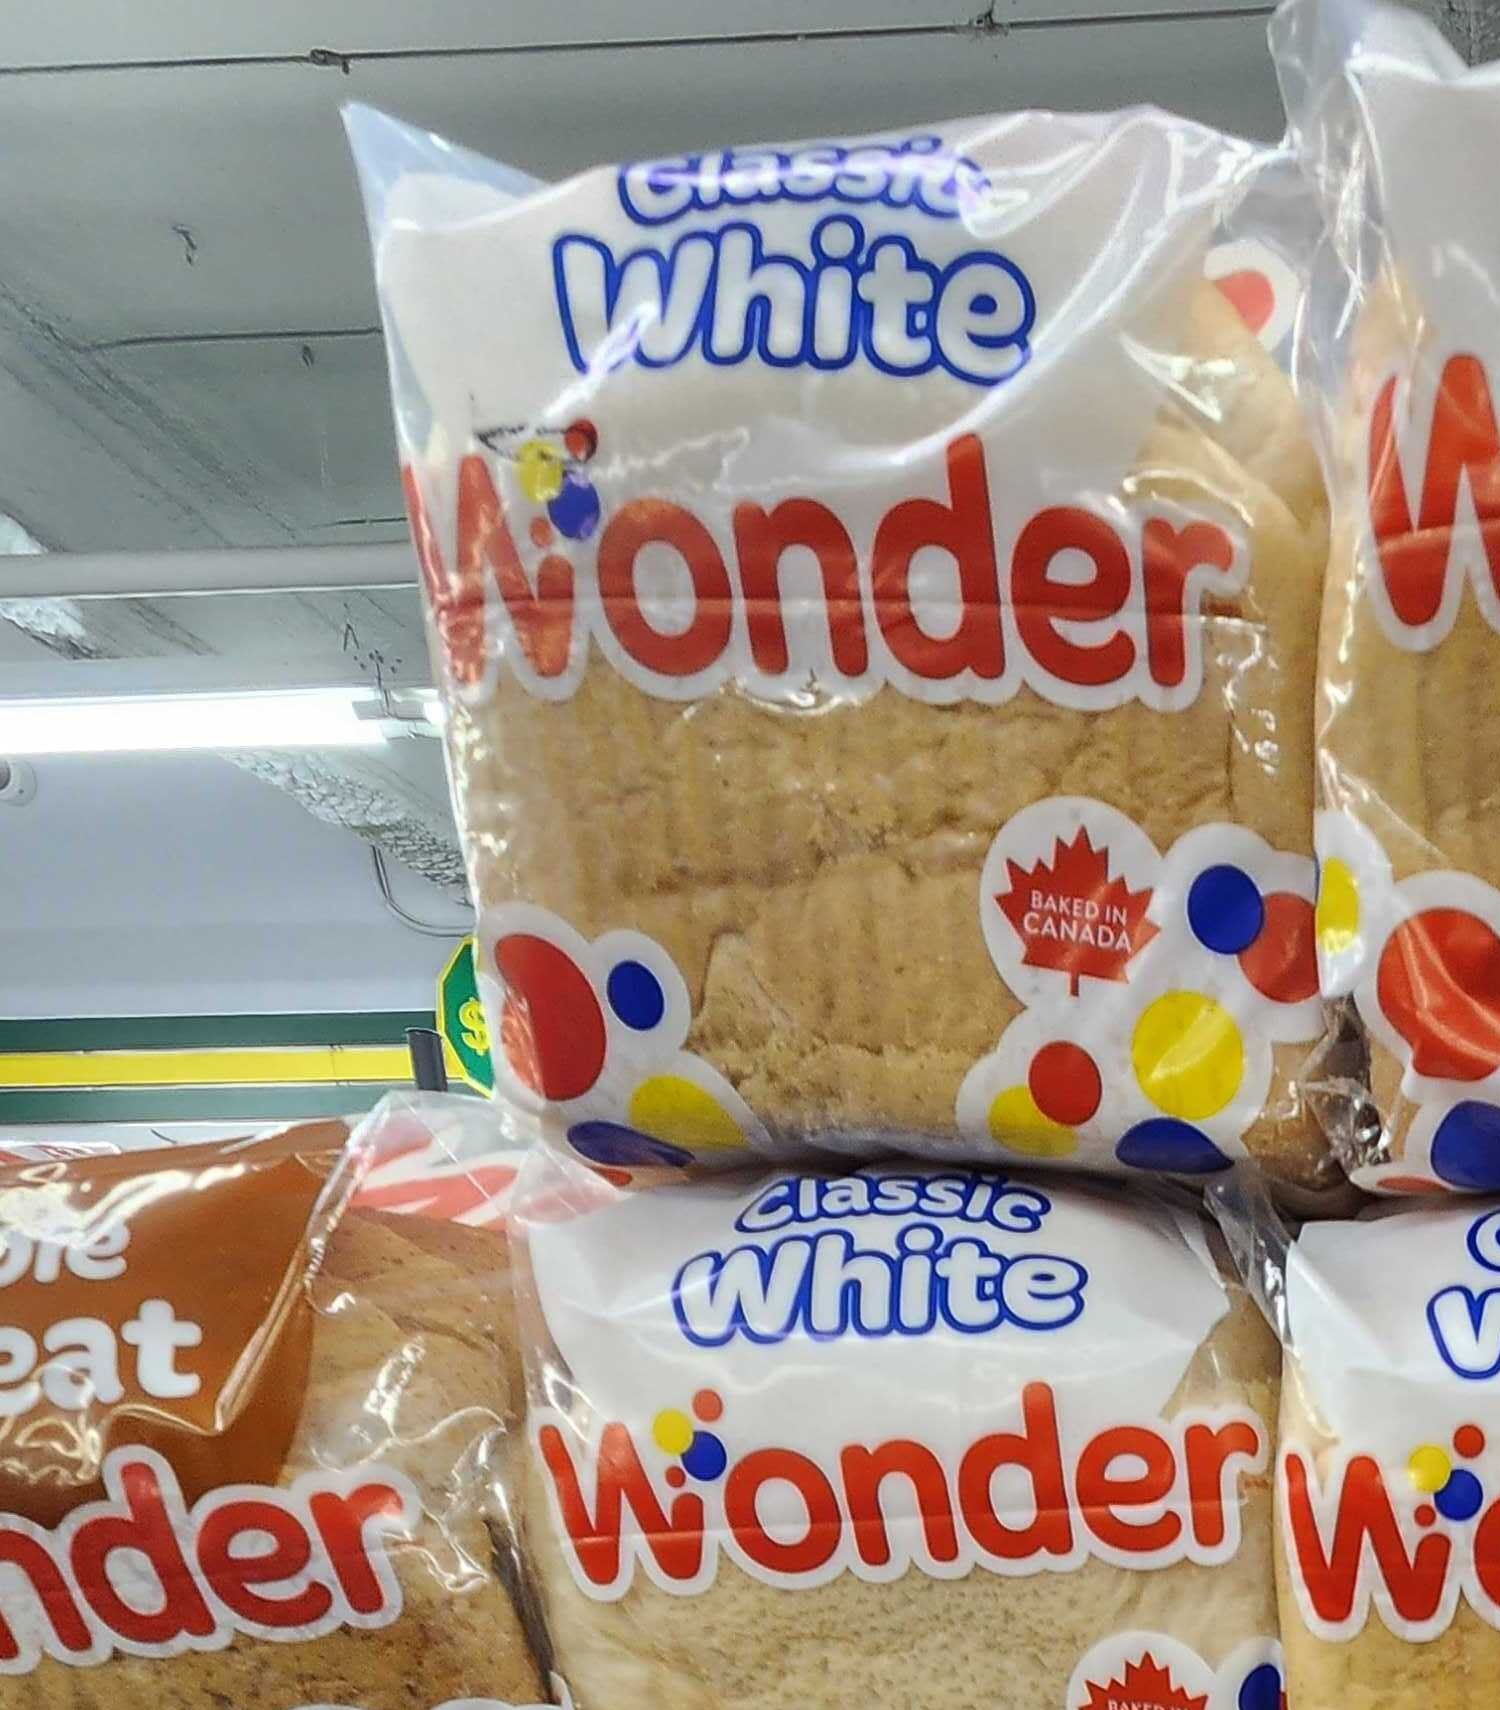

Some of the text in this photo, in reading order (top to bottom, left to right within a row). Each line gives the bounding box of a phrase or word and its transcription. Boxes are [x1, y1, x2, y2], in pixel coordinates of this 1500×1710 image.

[554, 214, 1034, 387] White
[402, 432, 1235, 689] Wonder
[1022, 912, 1133, 952] CANADA
[1030, 890, 1128, 925] BAKED IN
[736, 1173, 1051, 1233] Classic
[673, 1222, 1088, 1348] White
[539, 1382, 1259, 1585] Wonder
